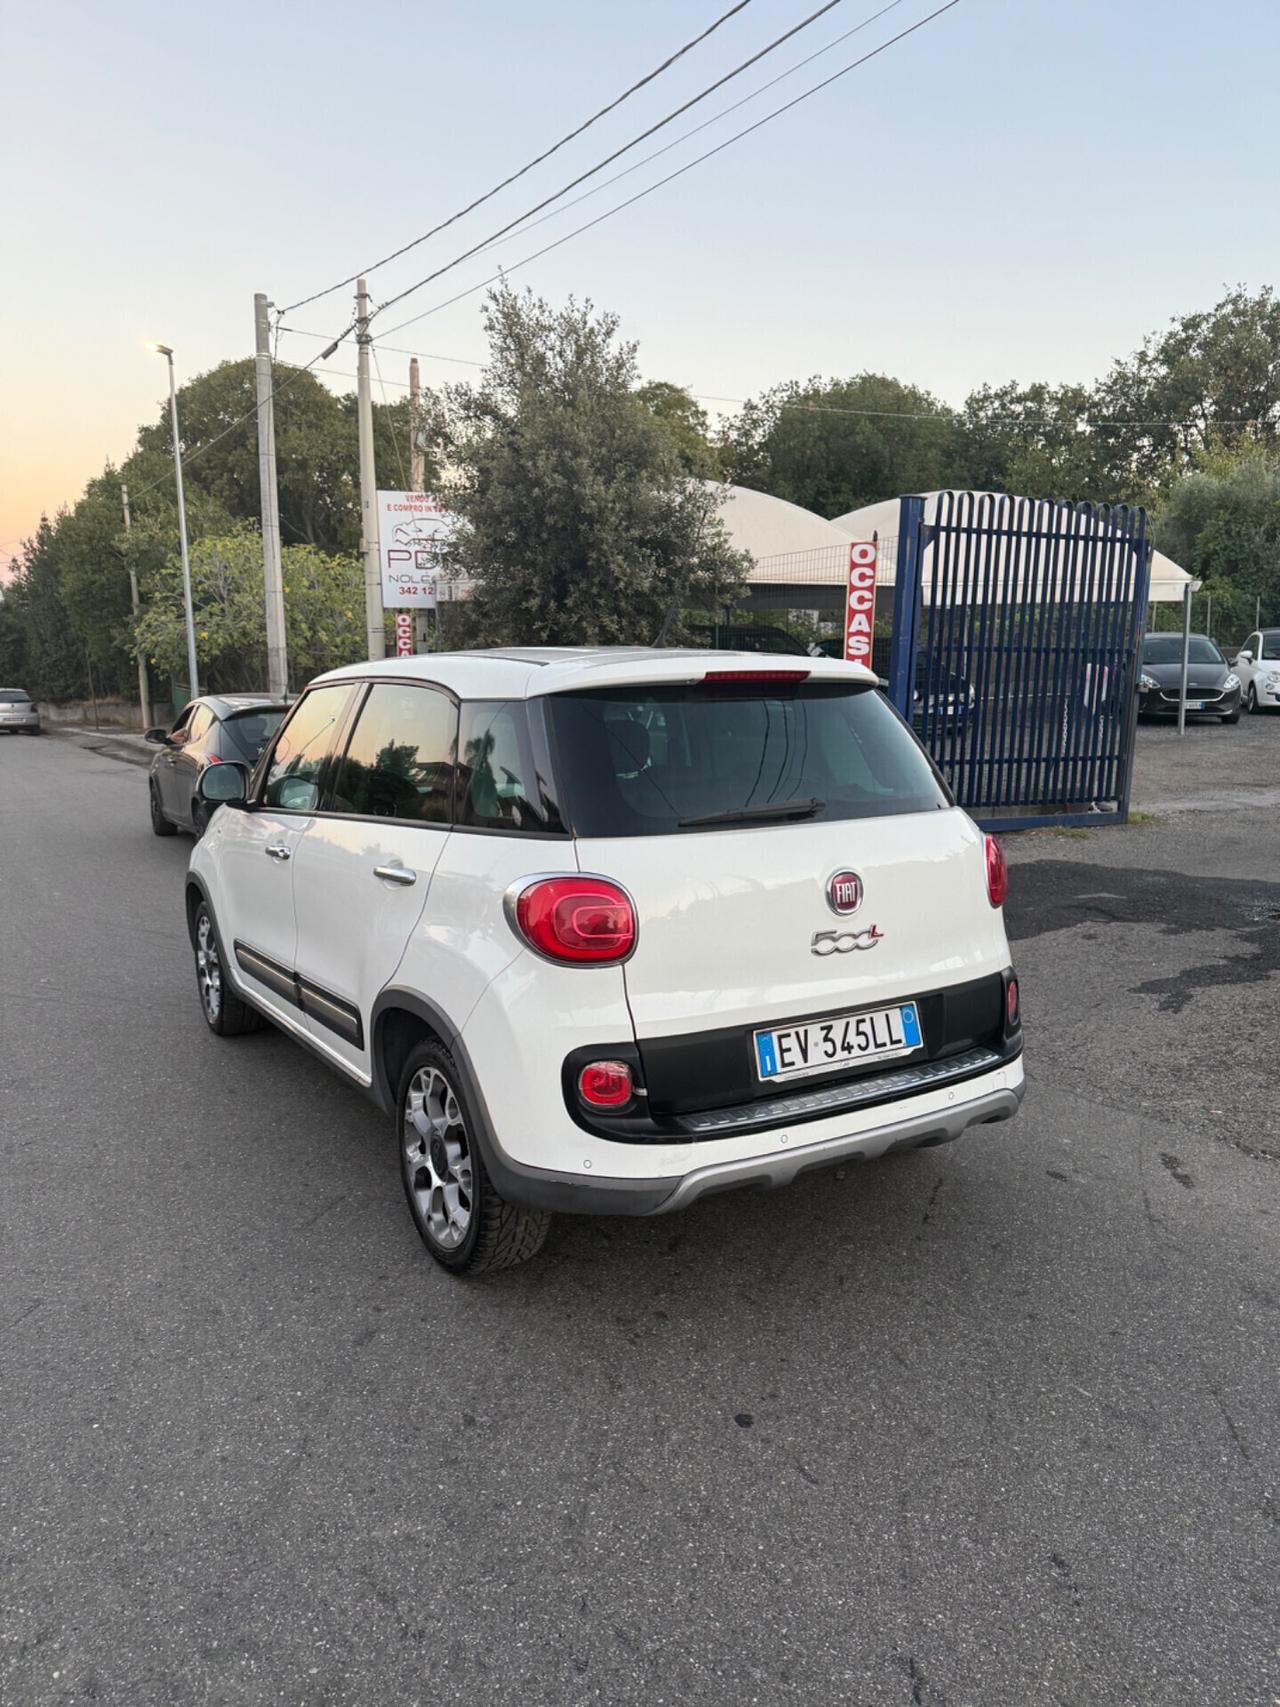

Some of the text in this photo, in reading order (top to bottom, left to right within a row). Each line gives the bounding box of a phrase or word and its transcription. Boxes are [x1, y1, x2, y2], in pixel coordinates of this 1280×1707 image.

[393, 504, 423, 512] COMPRO
[399, 587, 419, 595] 342
[847, 543, 876, 665] OCCAS
[836, 881, 857, 904] FIAT
